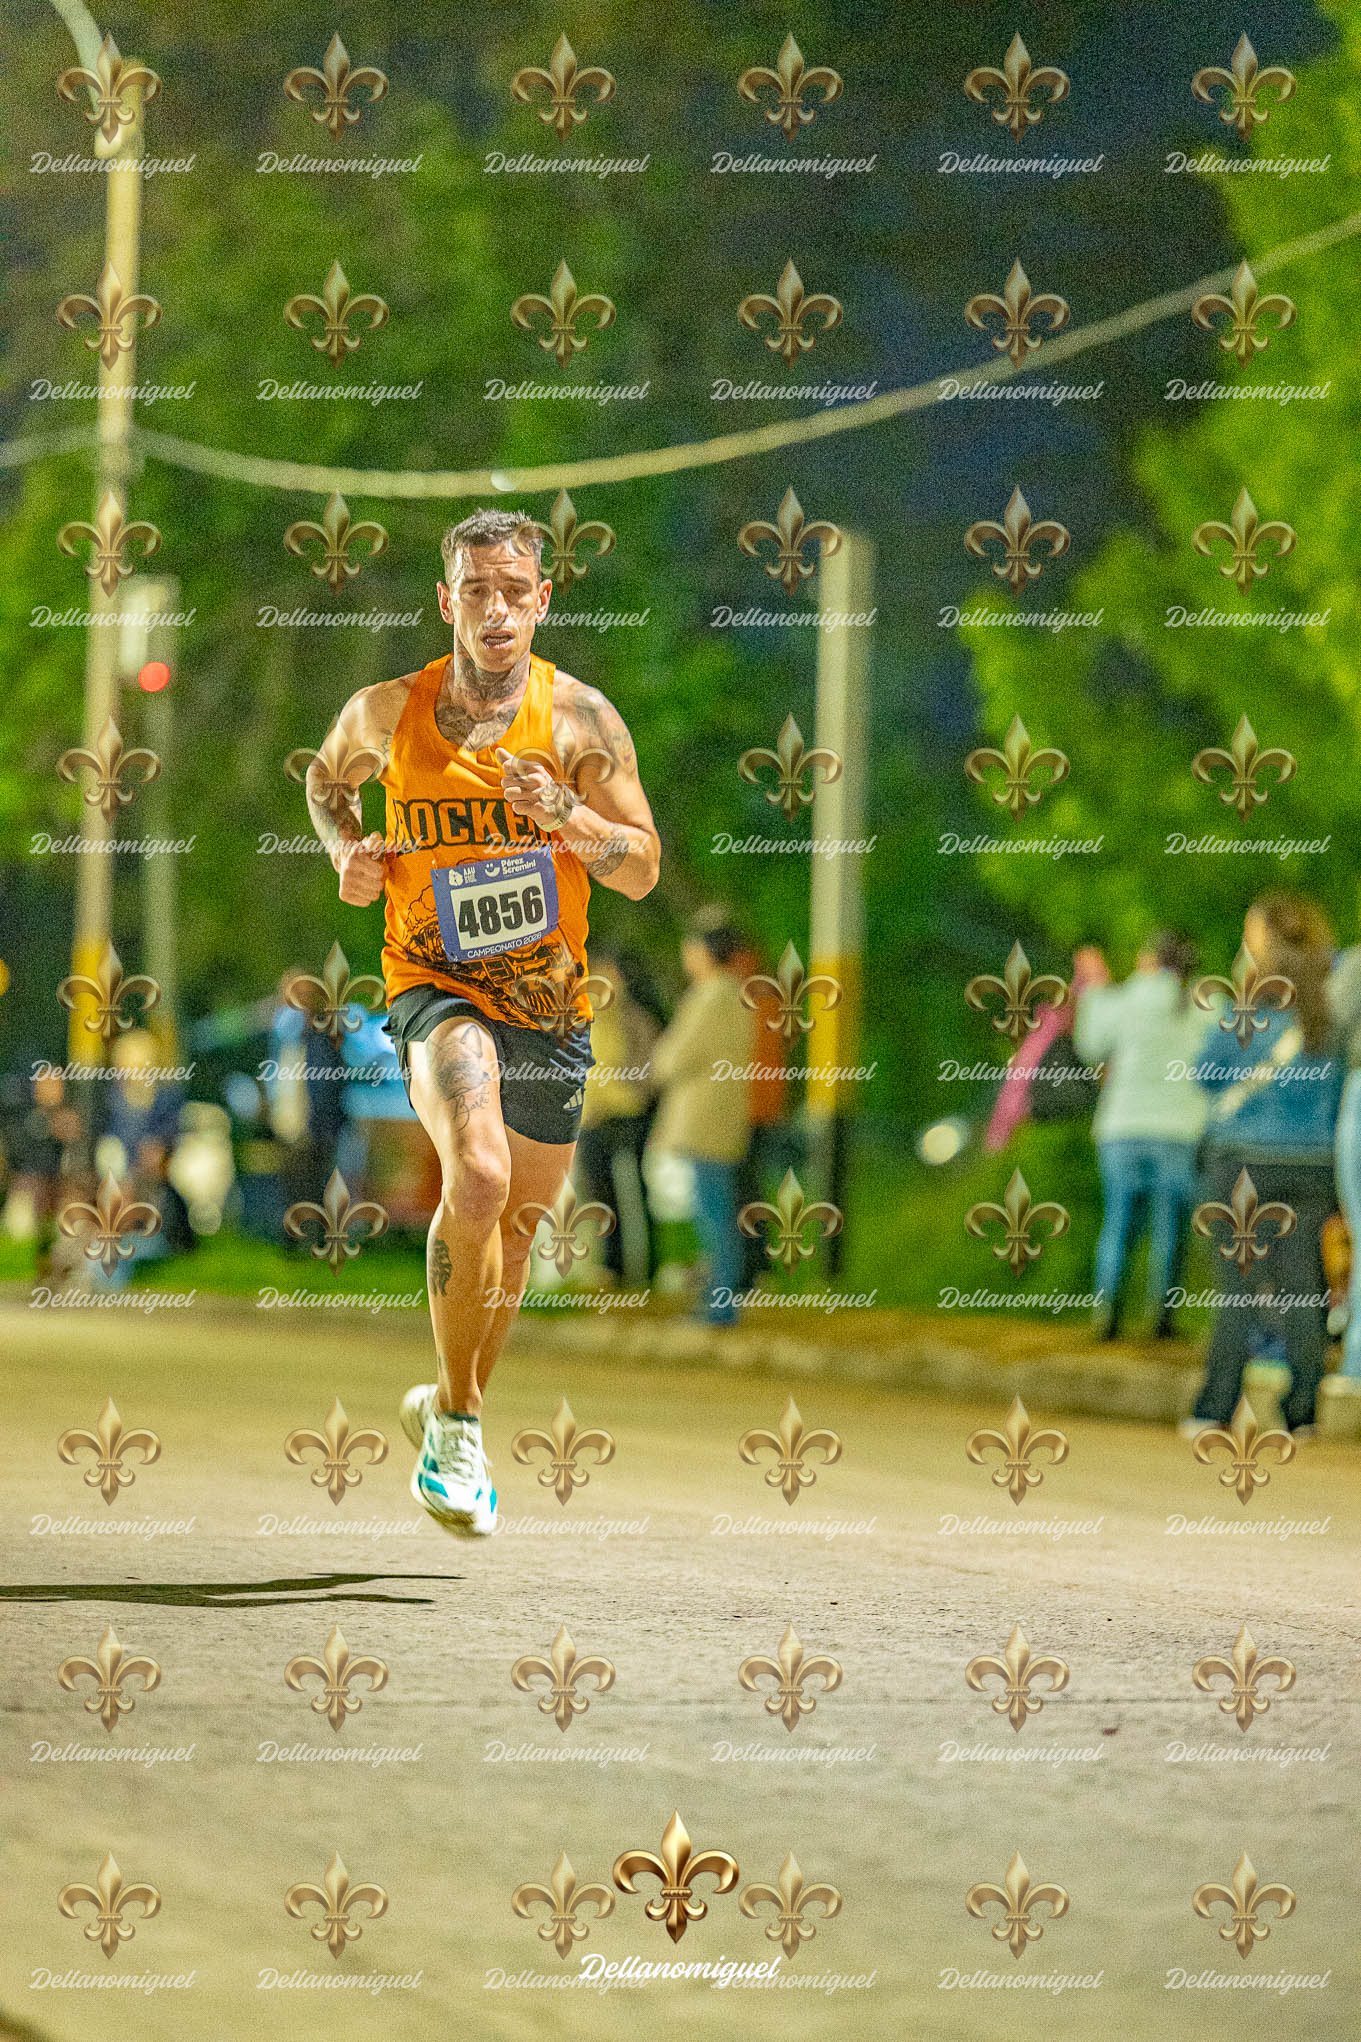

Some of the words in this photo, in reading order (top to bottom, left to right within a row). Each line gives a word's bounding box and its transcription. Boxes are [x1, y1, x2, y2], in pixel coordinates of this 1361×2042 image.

[392, 798, 551, 856] ROCKE
[501, 857, 524, 868] Pérez
[502, 859, 537, 875] Scremini
[458, 885, 544, 939] 4856
[467, 939, 523, 958] CAMPEONATO
